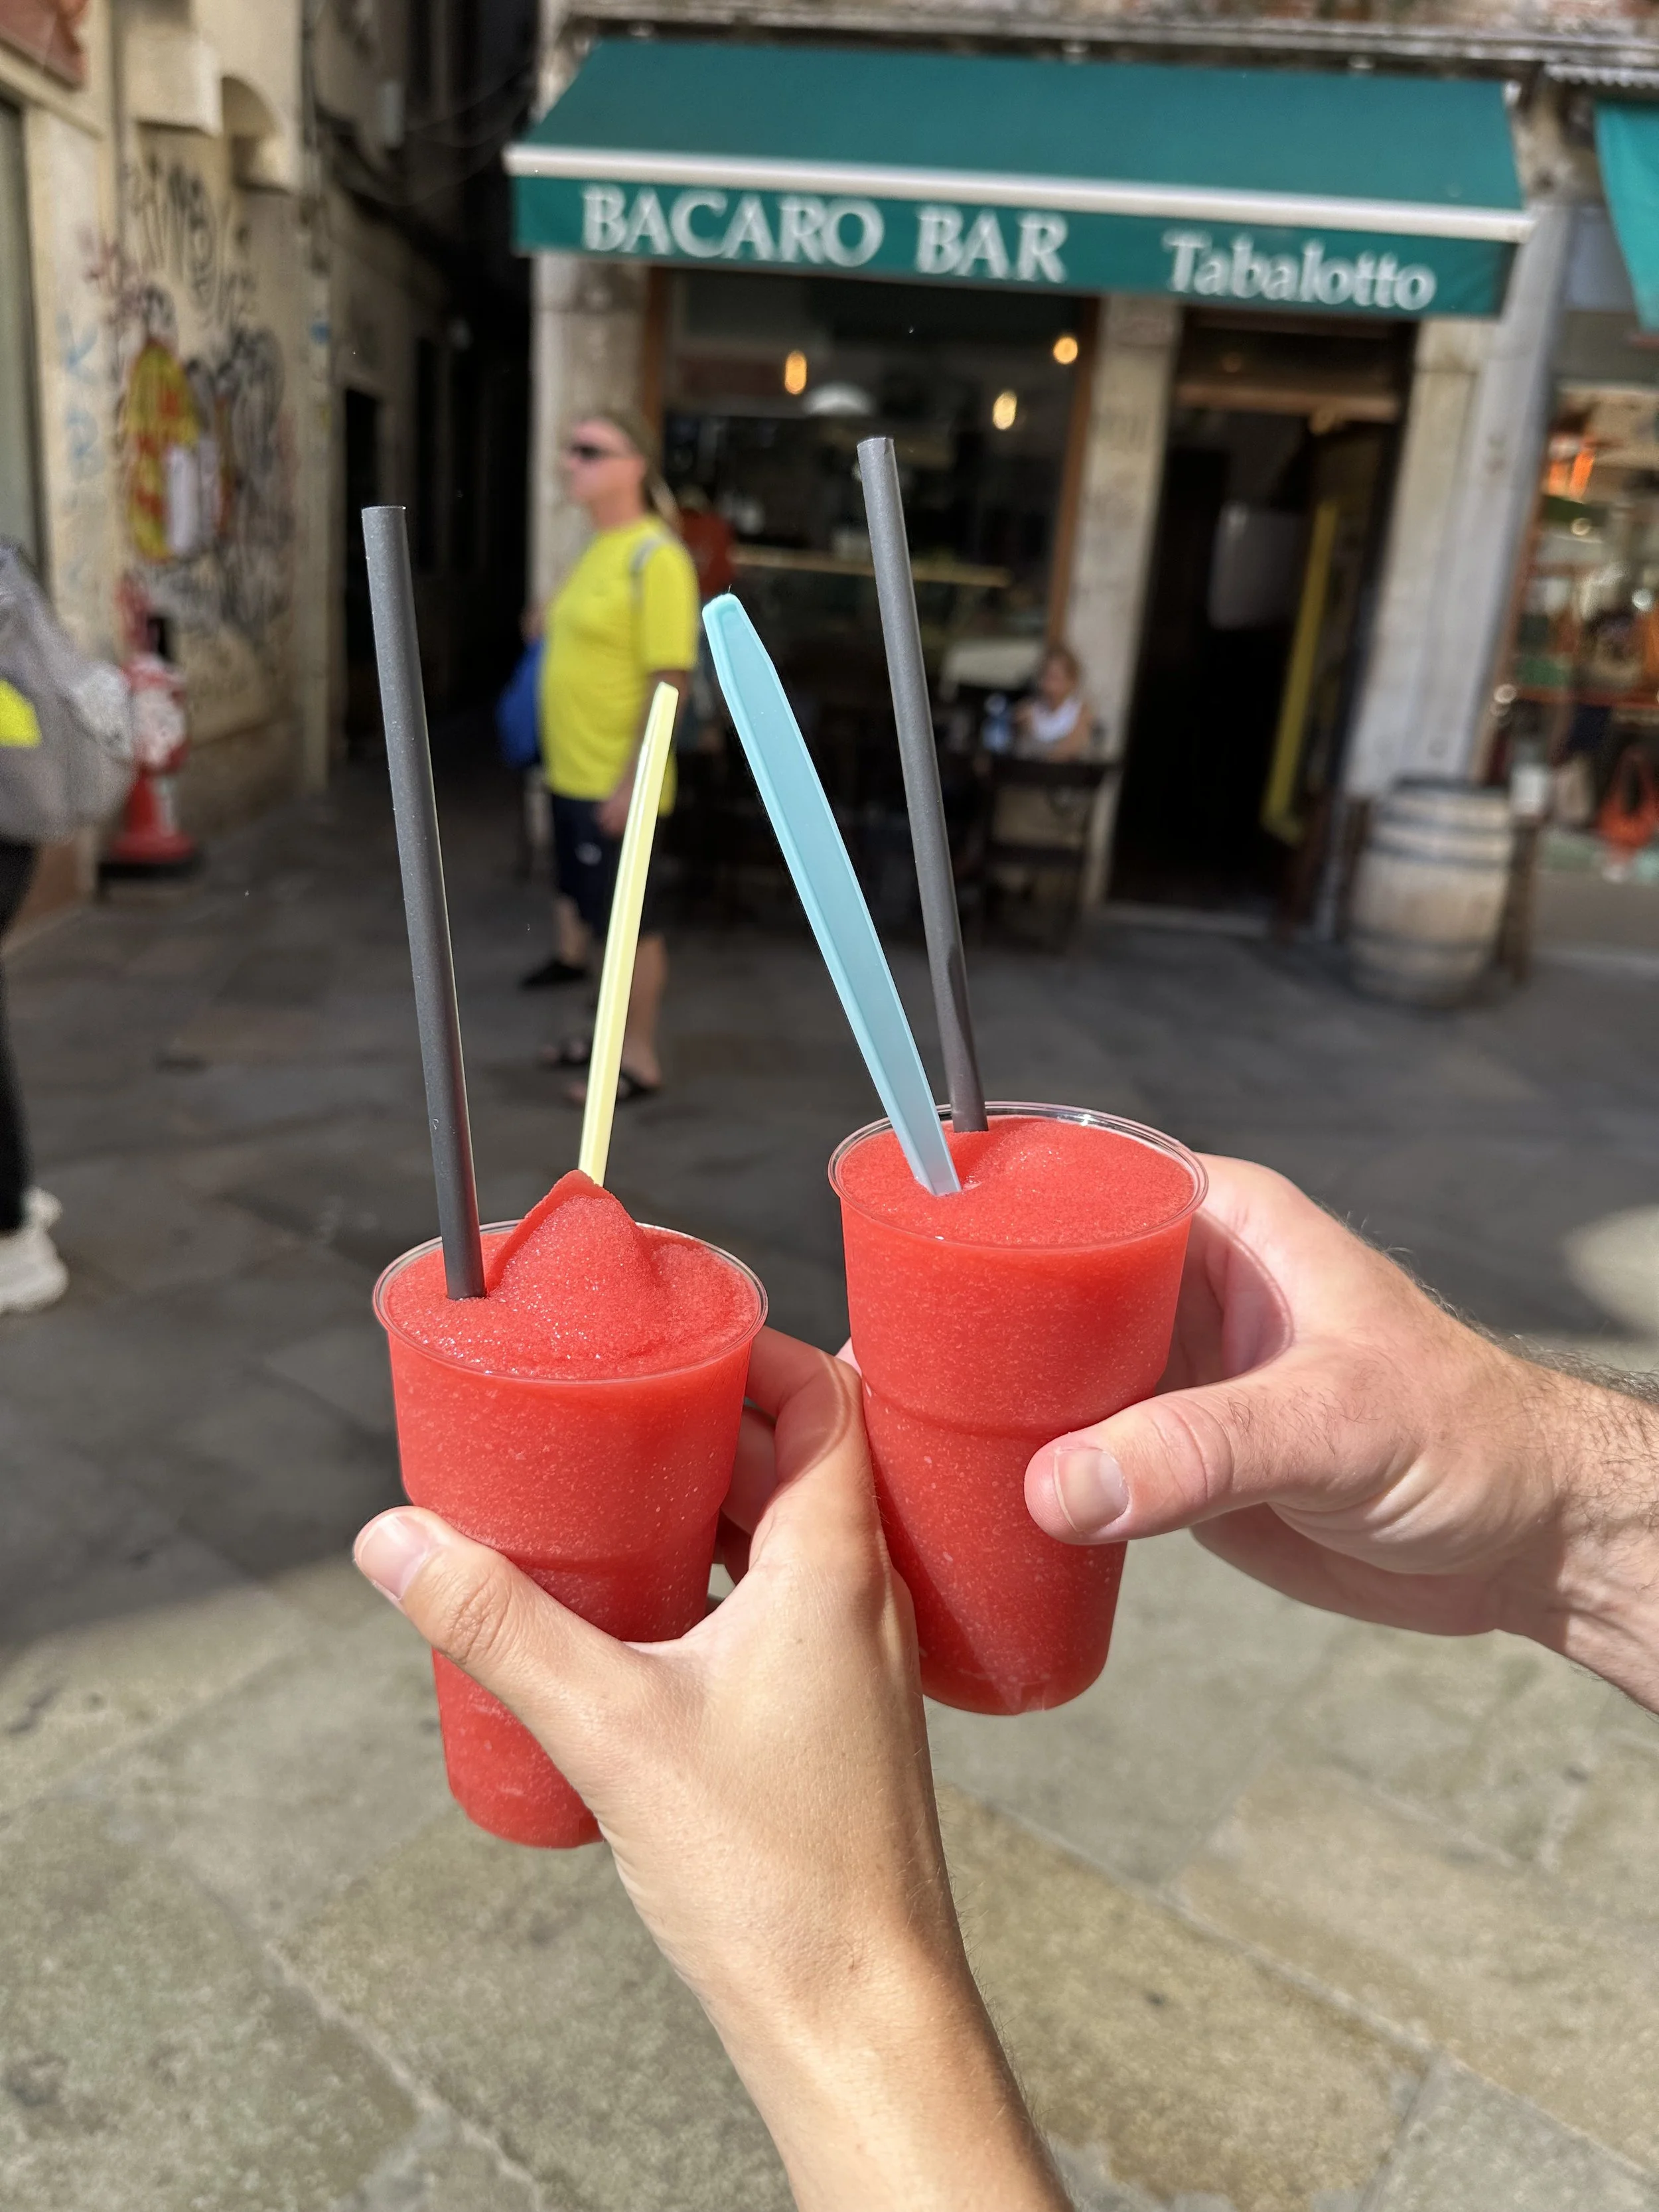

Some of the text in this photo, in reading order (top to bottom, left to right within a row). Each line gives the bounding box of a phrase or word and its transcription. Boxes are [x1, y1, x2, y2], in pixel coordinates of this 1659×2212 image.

[583, 184, 1437, 311] BACARO BAR Tabalotto
